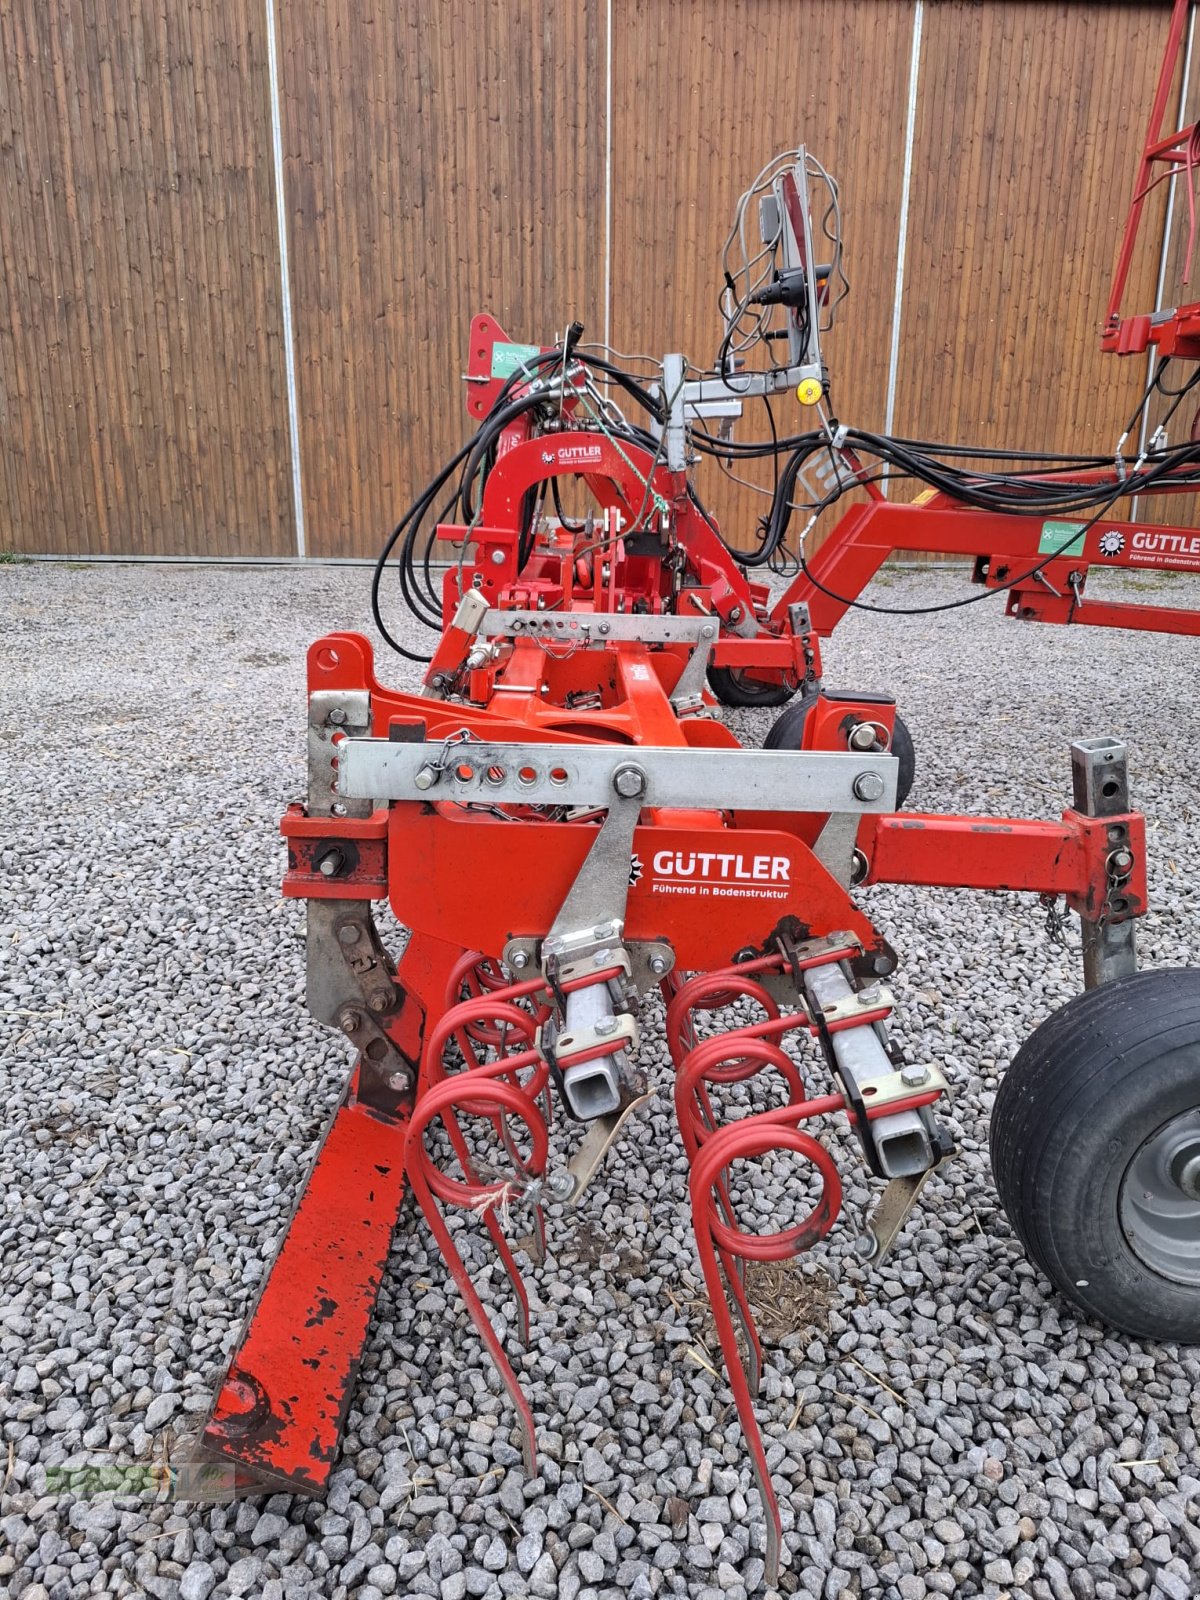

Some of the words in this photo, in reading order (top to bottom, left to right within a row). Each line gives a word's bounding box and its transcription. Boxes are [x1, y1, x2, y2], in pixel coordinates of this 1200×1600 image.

[1129, 554, 1156, 562] Führend
[1156, 555, 1163, 563] in
[653, 850, 790, 880] GÜTTLER
[652, 884, 697, 895] Führend
[699, 886, 709, 896] in
[712, 887, 789, 899] Bodenstruktur
